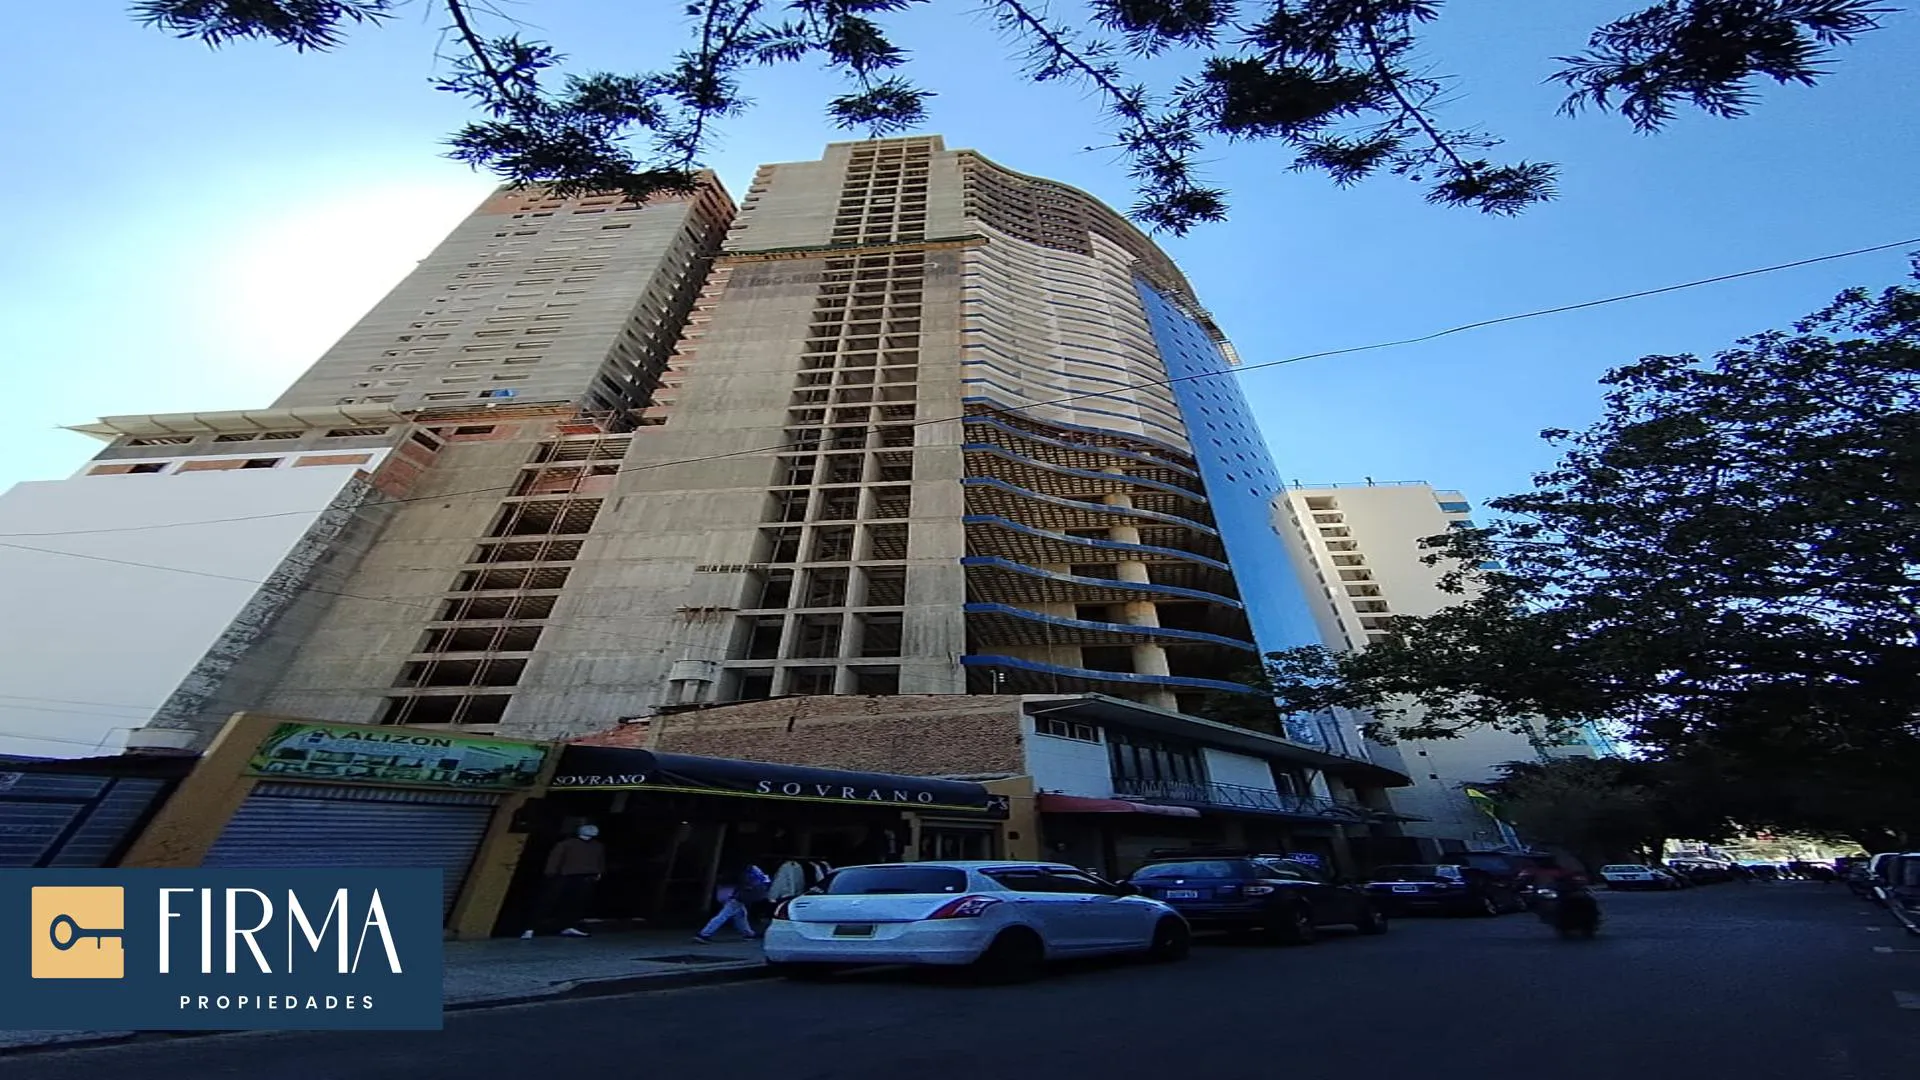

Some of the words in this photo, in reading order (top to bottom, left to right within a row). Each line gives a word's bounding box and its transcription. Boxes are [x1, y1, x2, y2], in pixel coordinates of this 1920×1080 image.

[341, 731, 452, 748] ALIZON
[552, 774, 646, 786] SOVRANO
[756, 780, 934, 804] SOVRANO
